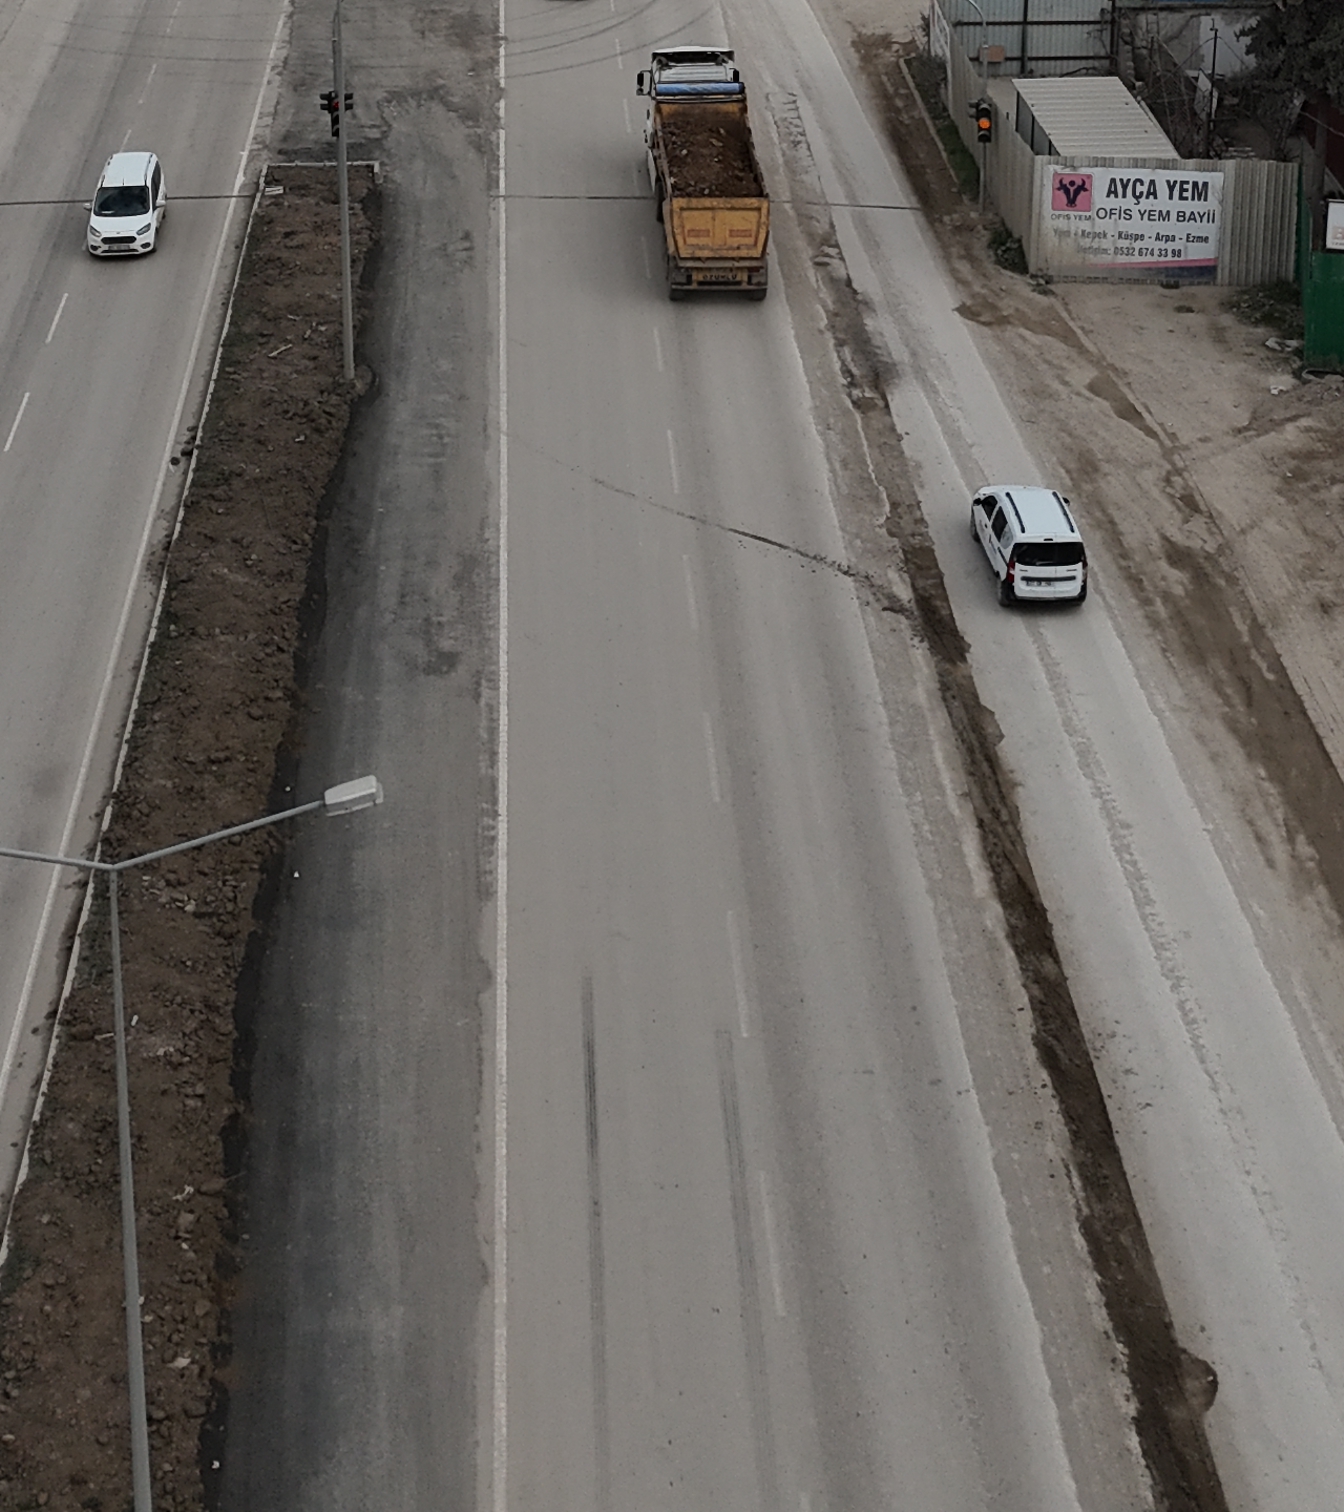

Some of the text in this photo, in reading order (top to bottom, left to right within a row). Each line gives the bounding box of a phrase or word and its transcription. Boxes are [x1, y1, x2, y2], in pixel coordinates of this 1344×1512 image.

[1106, 177, 1209, 205] AYÇA YEM
[1096, 206, 1133, 220] OFİS
[1138, 209, 1170, 222] YEM
[1155, 232, 1176, 243] Arpa
[1186, 233, 1209, 244] Ezme
[1114, 248, 1135, 257] 0532
[1158, 248, 1168, 258] 33
[1171, 249, 1182, 258] 98
